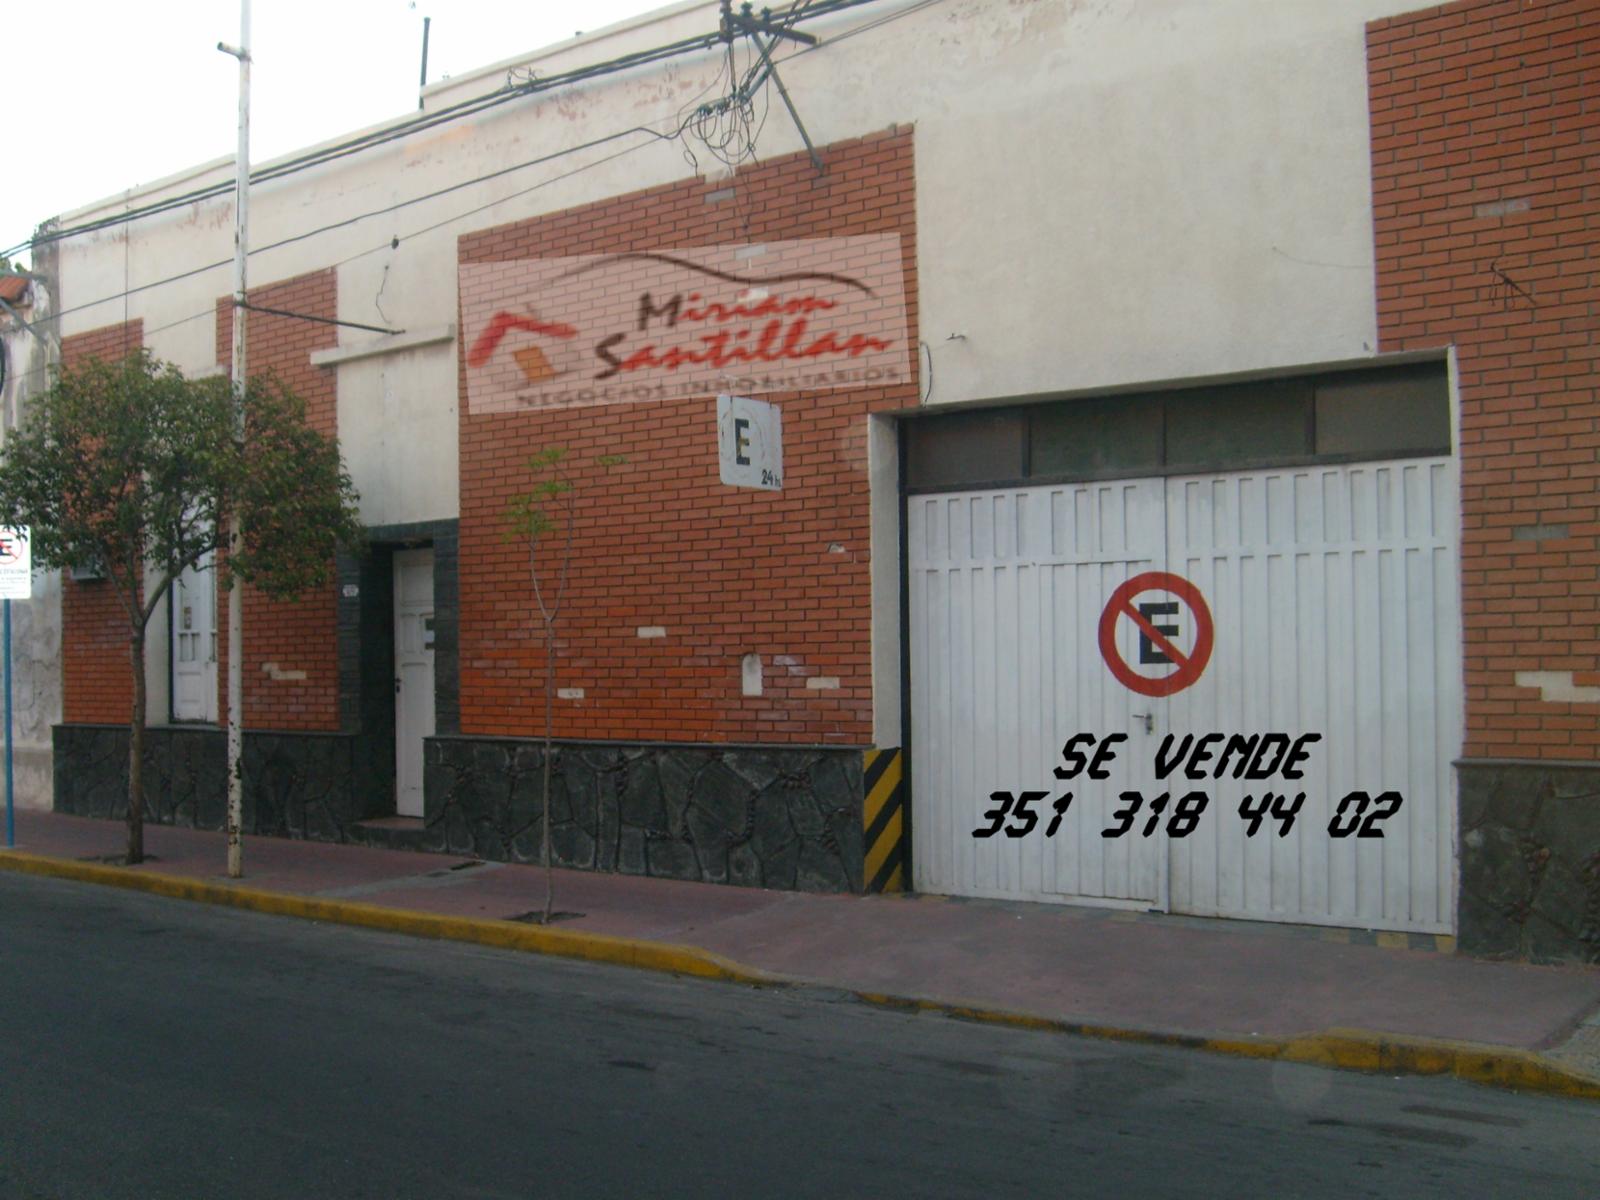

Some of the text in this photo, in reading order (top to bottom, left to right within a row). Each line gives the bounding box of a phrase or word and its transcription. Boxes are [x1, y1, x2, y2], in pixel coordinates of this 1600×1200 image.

[638, 291, 840, 331] Miriam
[595, 317, 893, 380] Santillan
[735, 418, 750, 466] E
[1139, 602, 1179, 664] E
